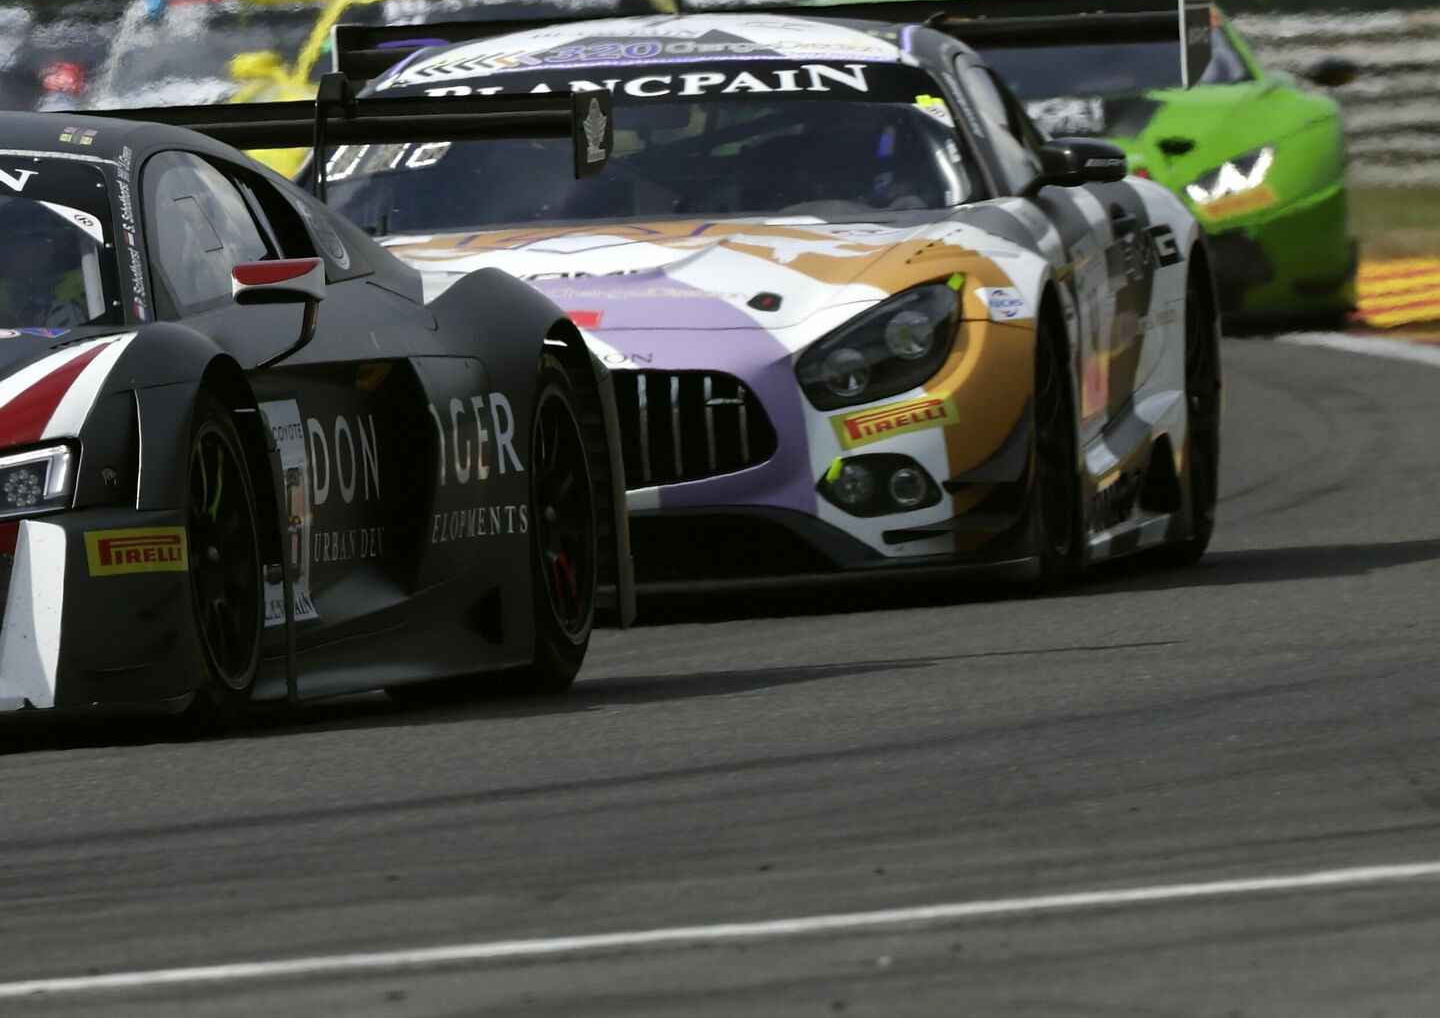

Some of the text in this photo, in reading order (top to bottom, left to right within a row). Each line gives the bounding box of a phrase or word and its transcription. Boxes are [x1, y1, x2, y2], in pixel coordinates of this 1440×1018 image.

[273, 423, 304, 443] COYOTE
[844, 398, 948, 441] PIRELLI
[97, 534, 182, 566] PIRELLI
[314, 531, 356, 563] URBAN
